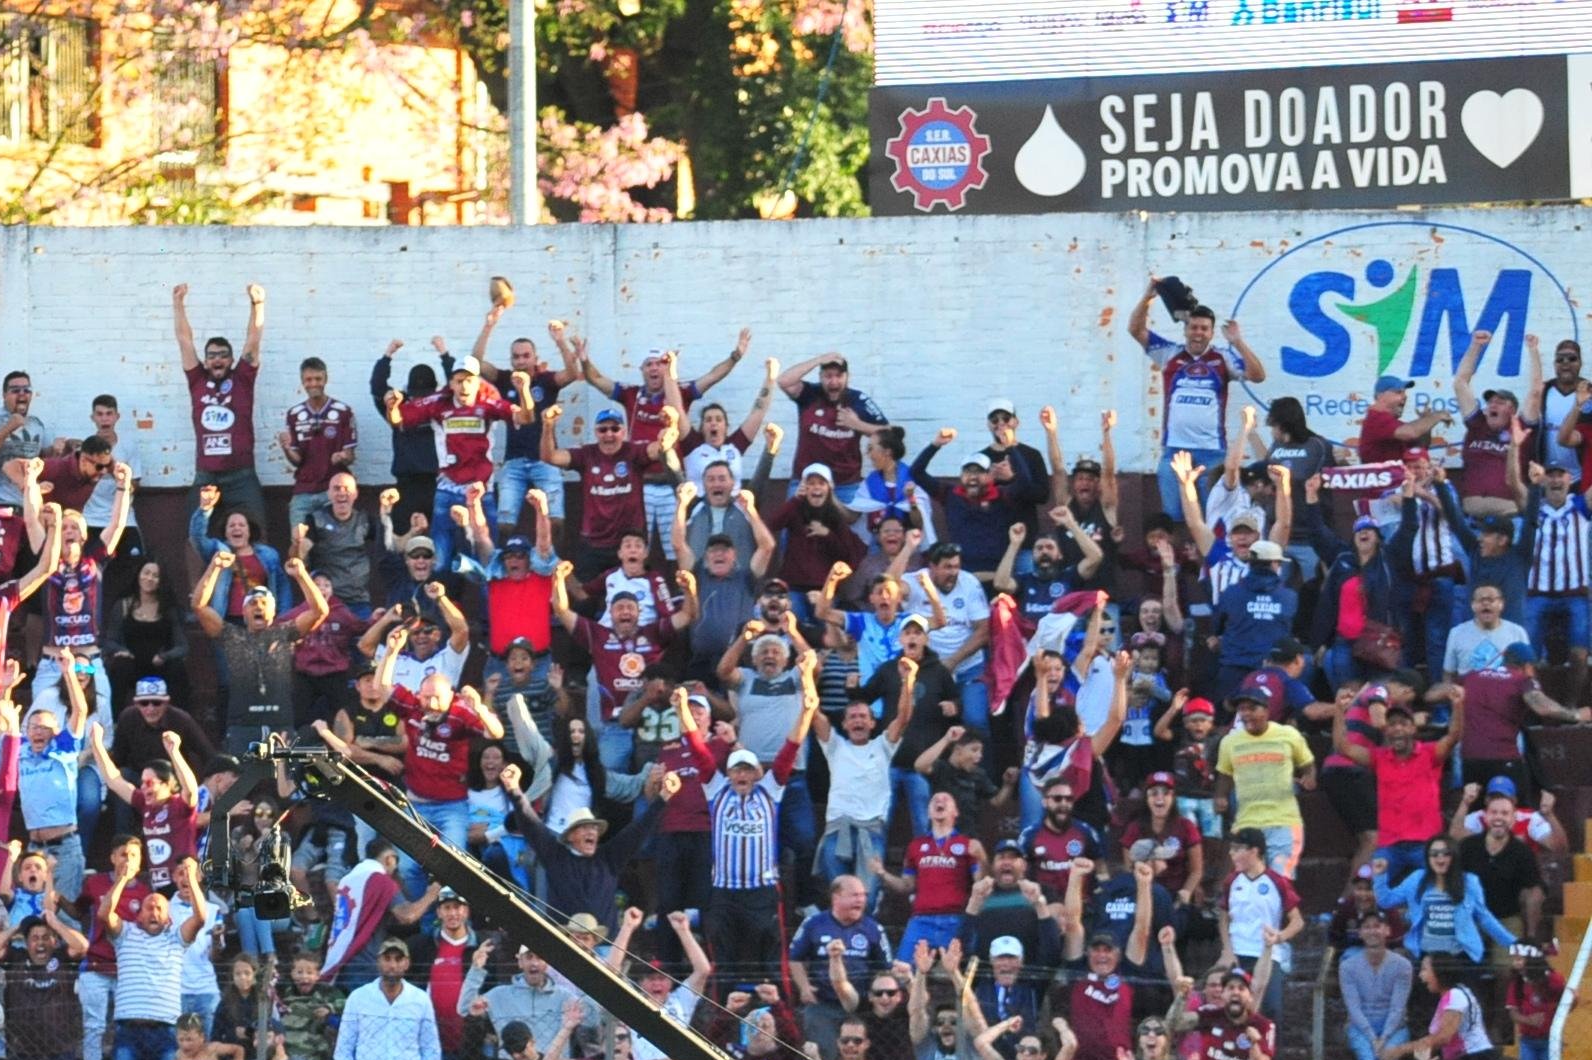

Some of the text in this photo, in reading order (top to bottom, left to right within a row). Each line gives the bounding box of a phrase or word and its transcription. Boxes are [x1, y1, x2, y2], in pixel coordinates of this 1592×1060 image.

[1099, 81, 1448, 154] SEJA DOADOR
[910, 146, 968, 165] CAXIAS
[922, 169, 936, 181] DO
[1101, 145, 1448, 199] PROMOVA A VIDA
[55, 633, 95, 646] VOGES
